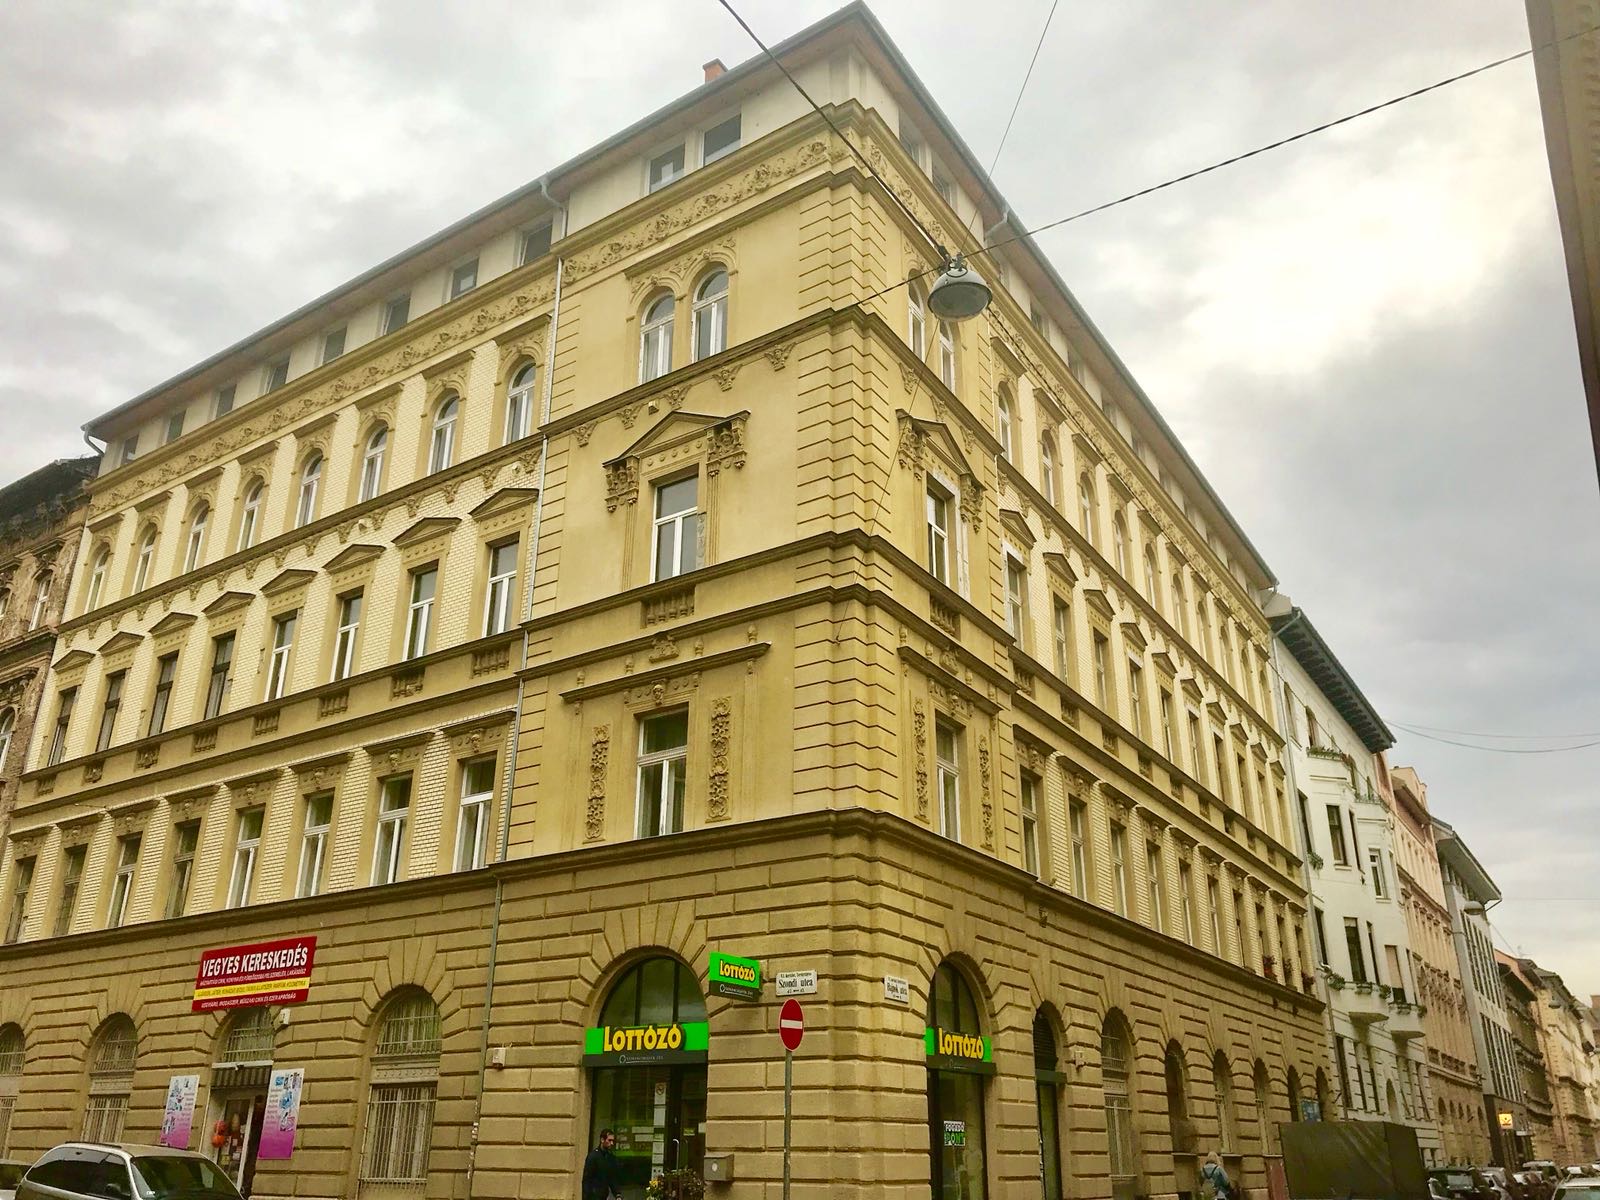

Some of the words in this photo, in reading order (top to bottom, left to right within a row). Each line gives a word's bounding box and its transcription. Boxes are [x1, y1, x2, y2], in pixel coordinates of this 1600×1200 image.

[202, 955, 240, 978] VEGYES
[240, 943, 308, 973] KERESKEDÉS
[719, 960, 755, 982] LOTTÓZÓ
[779, 979, 797, 988] Szondi
[800, 979, 813, 987] utca
[604, 1023, 682, 1052] LOTTÓZÓ
[938, 1028, 984, 1060] LOTTÓZÓ
